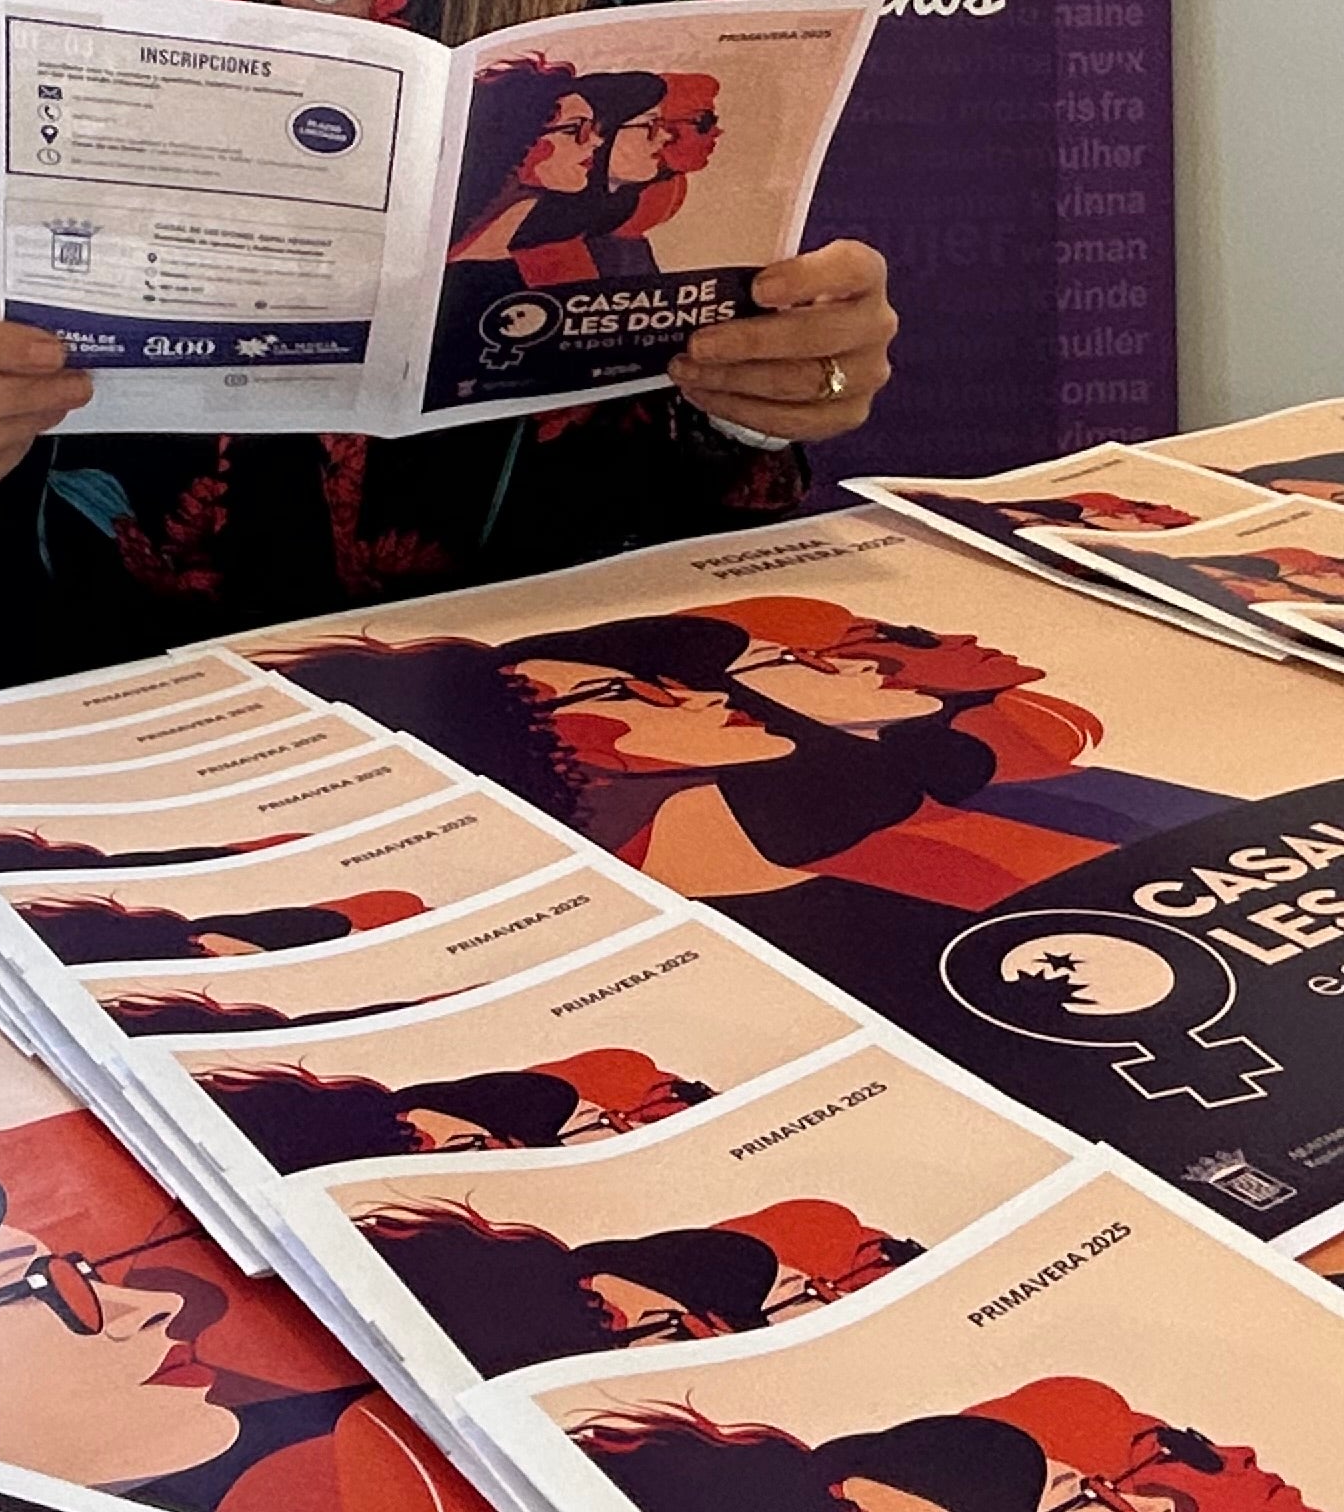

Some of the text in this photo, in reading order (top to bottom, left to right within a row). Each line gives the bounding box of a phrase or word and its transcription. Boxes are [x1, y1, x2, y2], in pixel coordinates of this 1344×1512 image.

[139, 46, 273, 78] INSCRIPCIONES
[562, 300, 736, 336] LES DONES
[566, 278, 717, 314] CASAL DE
[196, 744, 291, 777] PRIMAVERA
[257, 765, 393, 813] PRIMAVERA 2025
[340, 815, 480, 869] PRIMAVERA 2025
[444, 893, 593, 955] PRIMAVERA 2025
[550, 949, 701, 1019] PRIMAVERA 2025
[728, 1080, 888, 1162] PRIMAVERA 2025
[966, 1220, 1133, 1329] PRIMAVERA 2025
